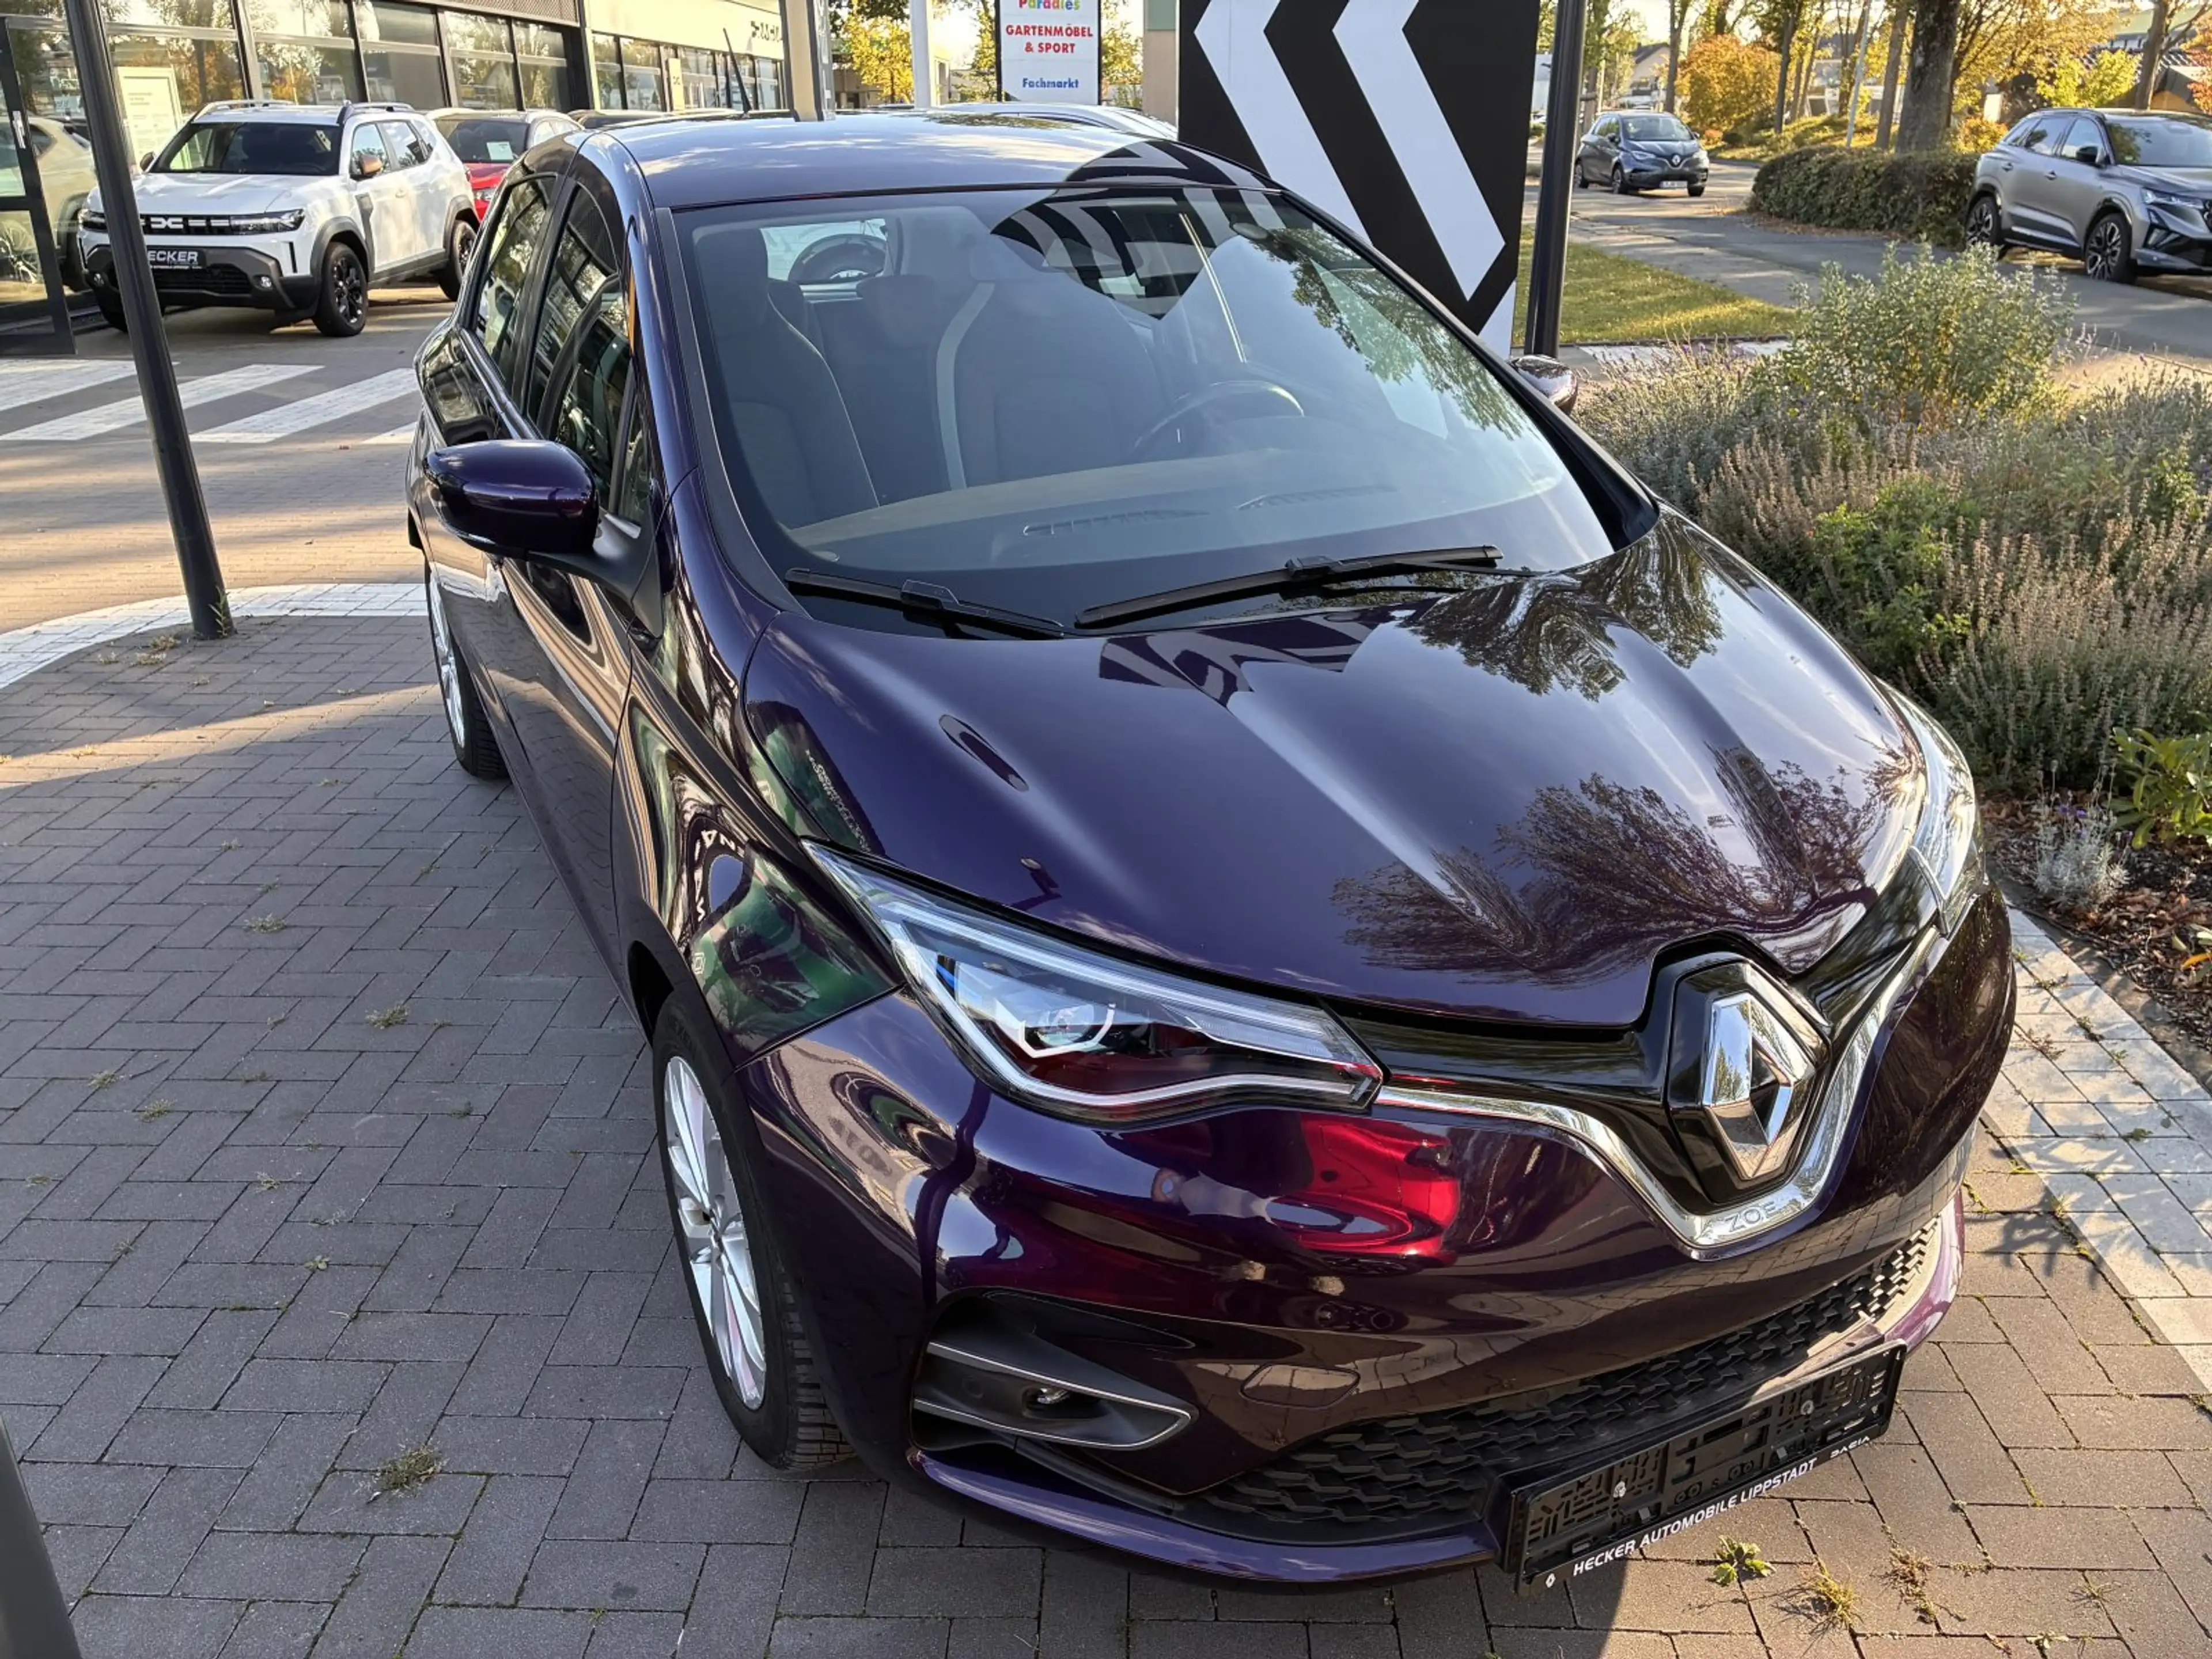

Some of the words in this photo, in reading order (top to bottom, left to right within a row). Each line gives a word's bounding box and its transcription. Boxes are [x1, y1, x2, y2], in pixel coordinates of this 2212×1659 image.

[1006, 24, 1093, 37] GARTENMÖBEL
[1025, 42, 1033, 53] &
[1038, 42, 1075, 53] SPORT
[1022, 77, 1079, 88] Fachmarkt
[147, 250, 199, 263] ECKER
[1725, 1200, 1779, 1232] ZOE
[1573, 1539, 1636, 1577] HECKER
[1639, 1494, 1737, 1548] AUTOMOBILE
[1740, 1457, 1817, 1503] LIPPSTADT
